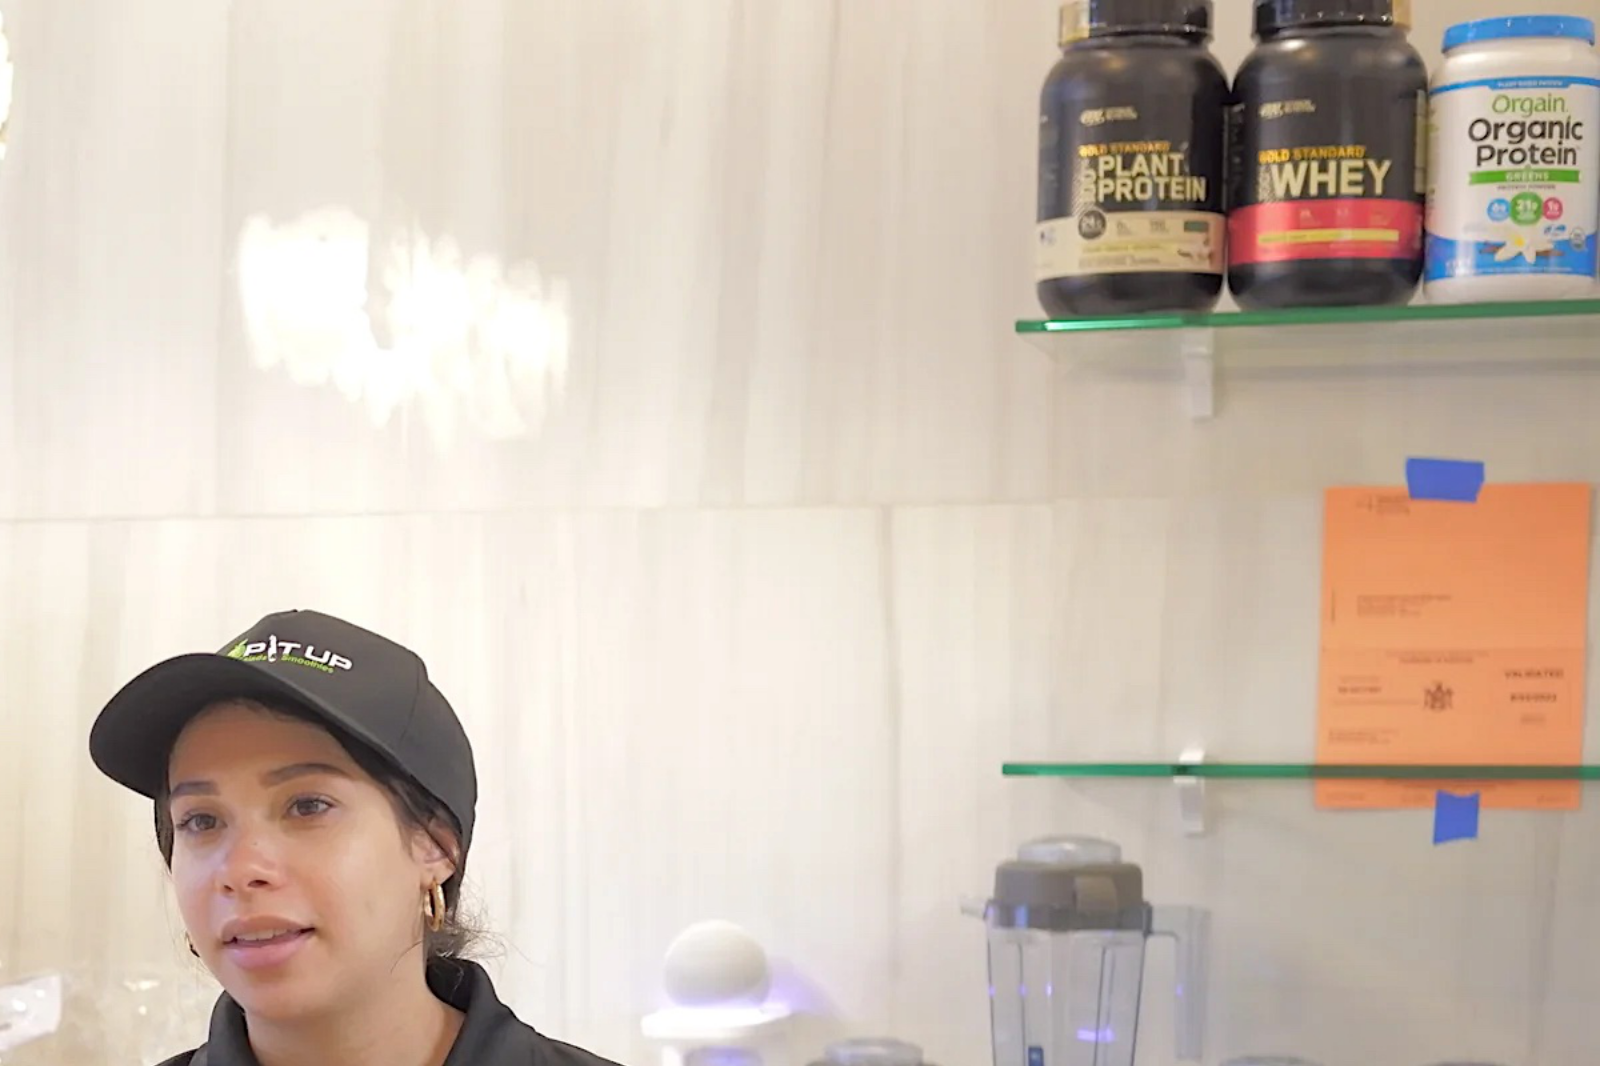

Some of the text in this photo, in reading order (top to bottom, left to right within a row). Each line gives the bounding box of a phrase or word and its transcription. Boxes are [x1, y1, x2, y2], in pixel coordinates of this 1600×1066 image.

[1492, 93, 1566, 118] Orgain
[1468, 115, 1583, 144] Organic
[1098, 152, 1185, 178] PLANT
[1293, 145, 1366, 160] STANDARD
[1476, 140, 1577, 167] Protein
[1097, 177, 1207, 202] PROTEIN
[1271, 159, 1392, 198] WHEY
[280, 654, 335, 674] Smoothies
[304, 645, 353, 671] UP
